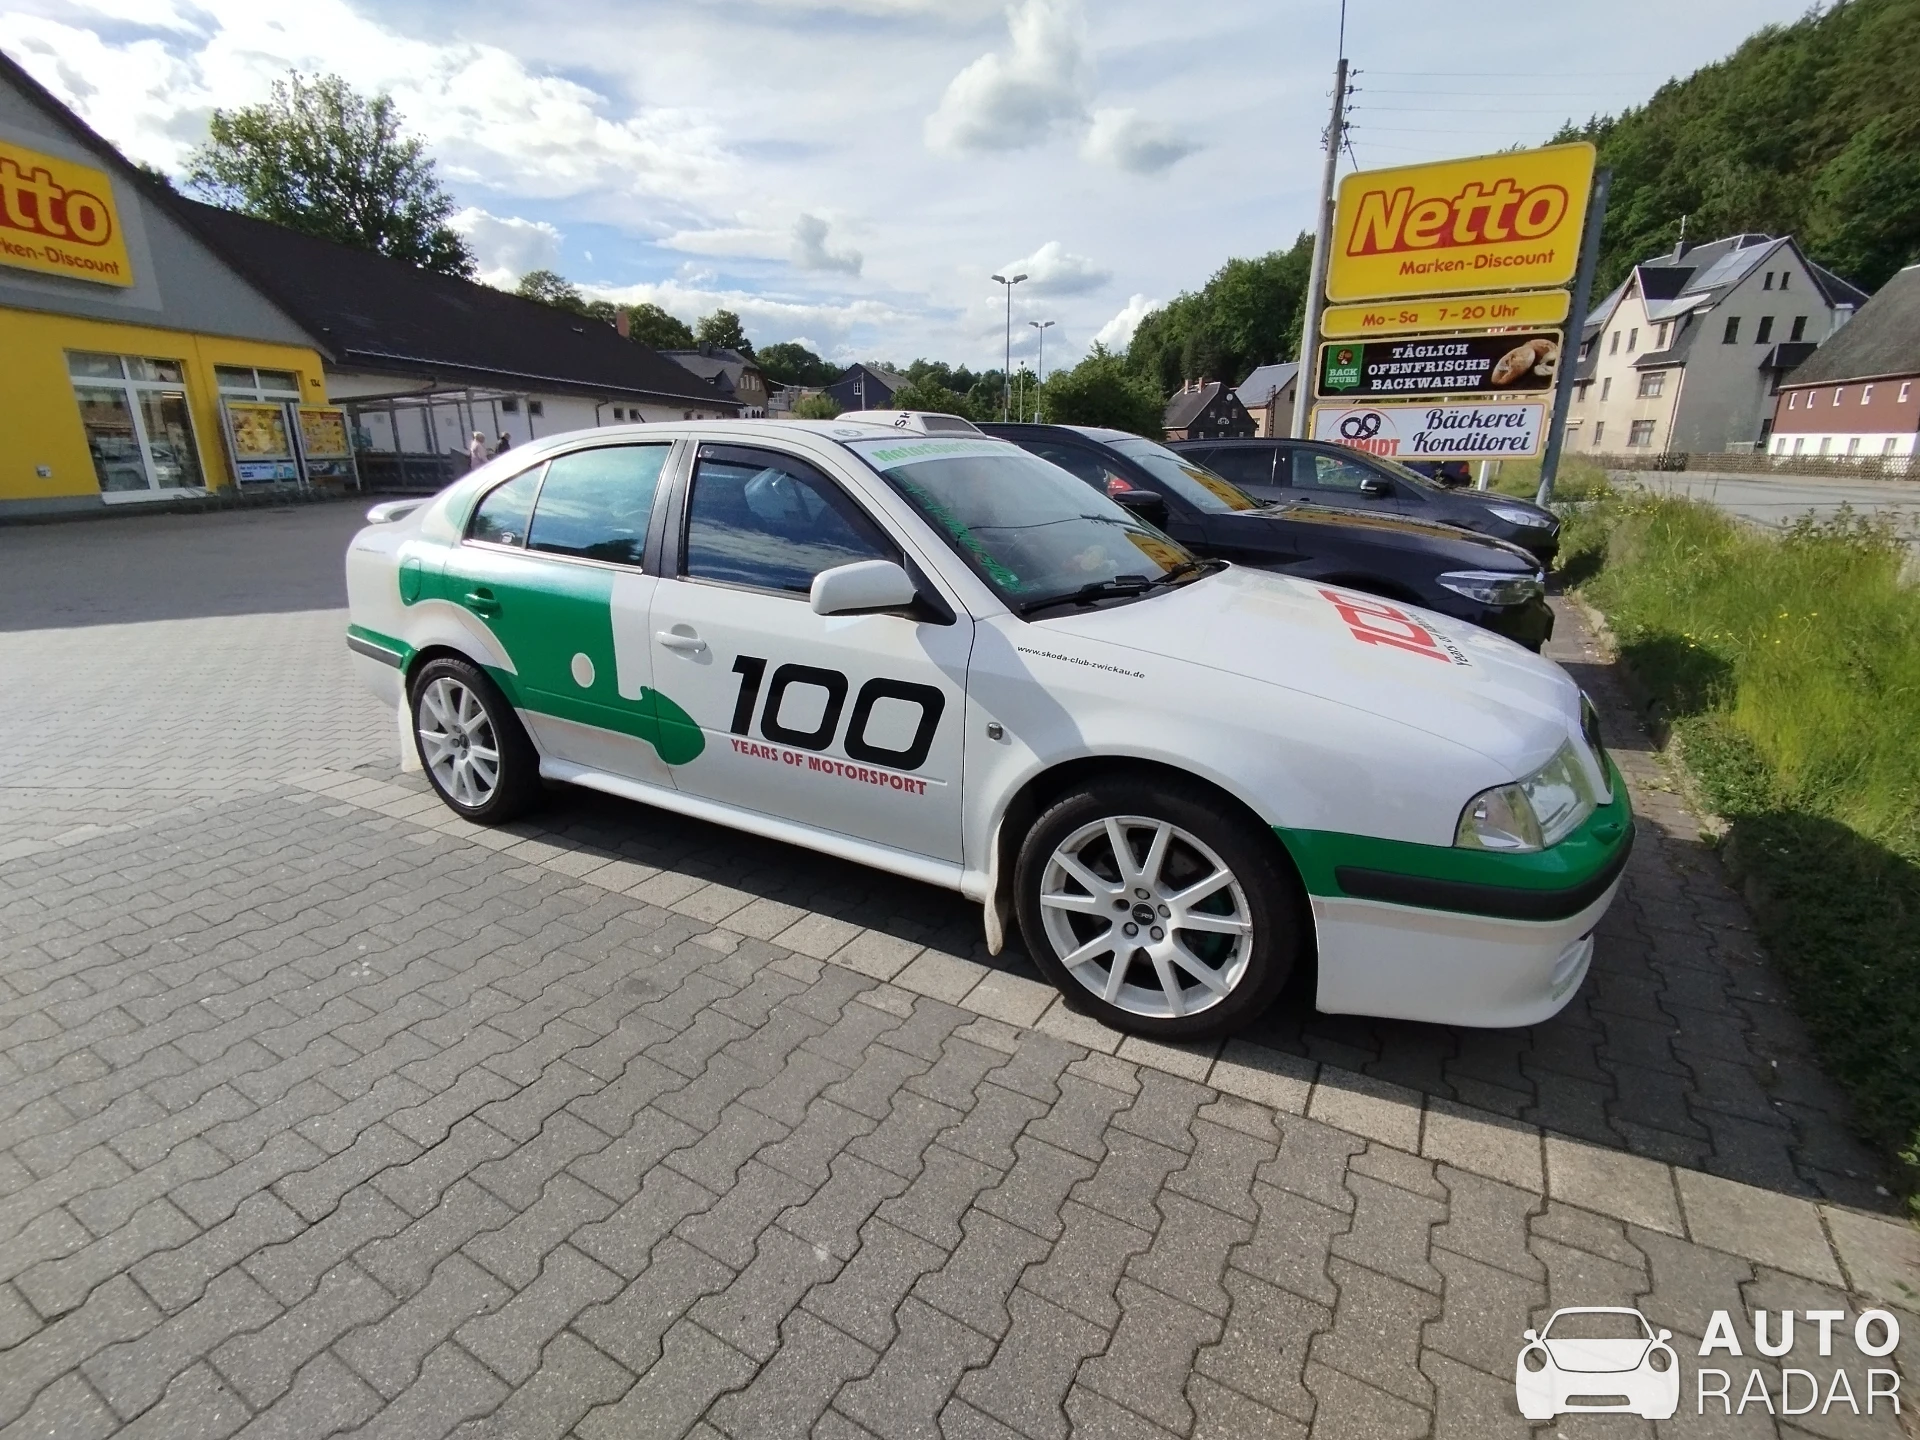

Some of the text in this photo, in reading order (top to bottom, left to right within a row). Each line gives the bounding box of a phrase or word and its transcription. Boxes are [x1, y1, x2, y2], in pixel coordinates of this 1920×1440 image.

[1346, 178, 1569, 257] Netto
[0, 237, 120, 275] ken-Discount
[1398, 249, 1555, 276] Marken-Discount
[1490, 304, 1520, 318] Uhr
[1392, 343, 1469, 360] TÄGLICH
[1328, 368, 1358, 377] BACK
[1367, 358, 1491, 376] OFENFRISCHE
[1327, 375, 1358, 384] STUBE
[1371, 375, 1482, 391] BACKWAREN
[1425, 407, 1527, 430] Bäckerei
[1412, 431, 1531, 454] Konditorei
[1017, 645, 1145, 679] www.skoda-club-zwickau.de
[730, 654, 946, 771] 100
[731, 738, 928, 796] YEARS OF MOTORSPORT
